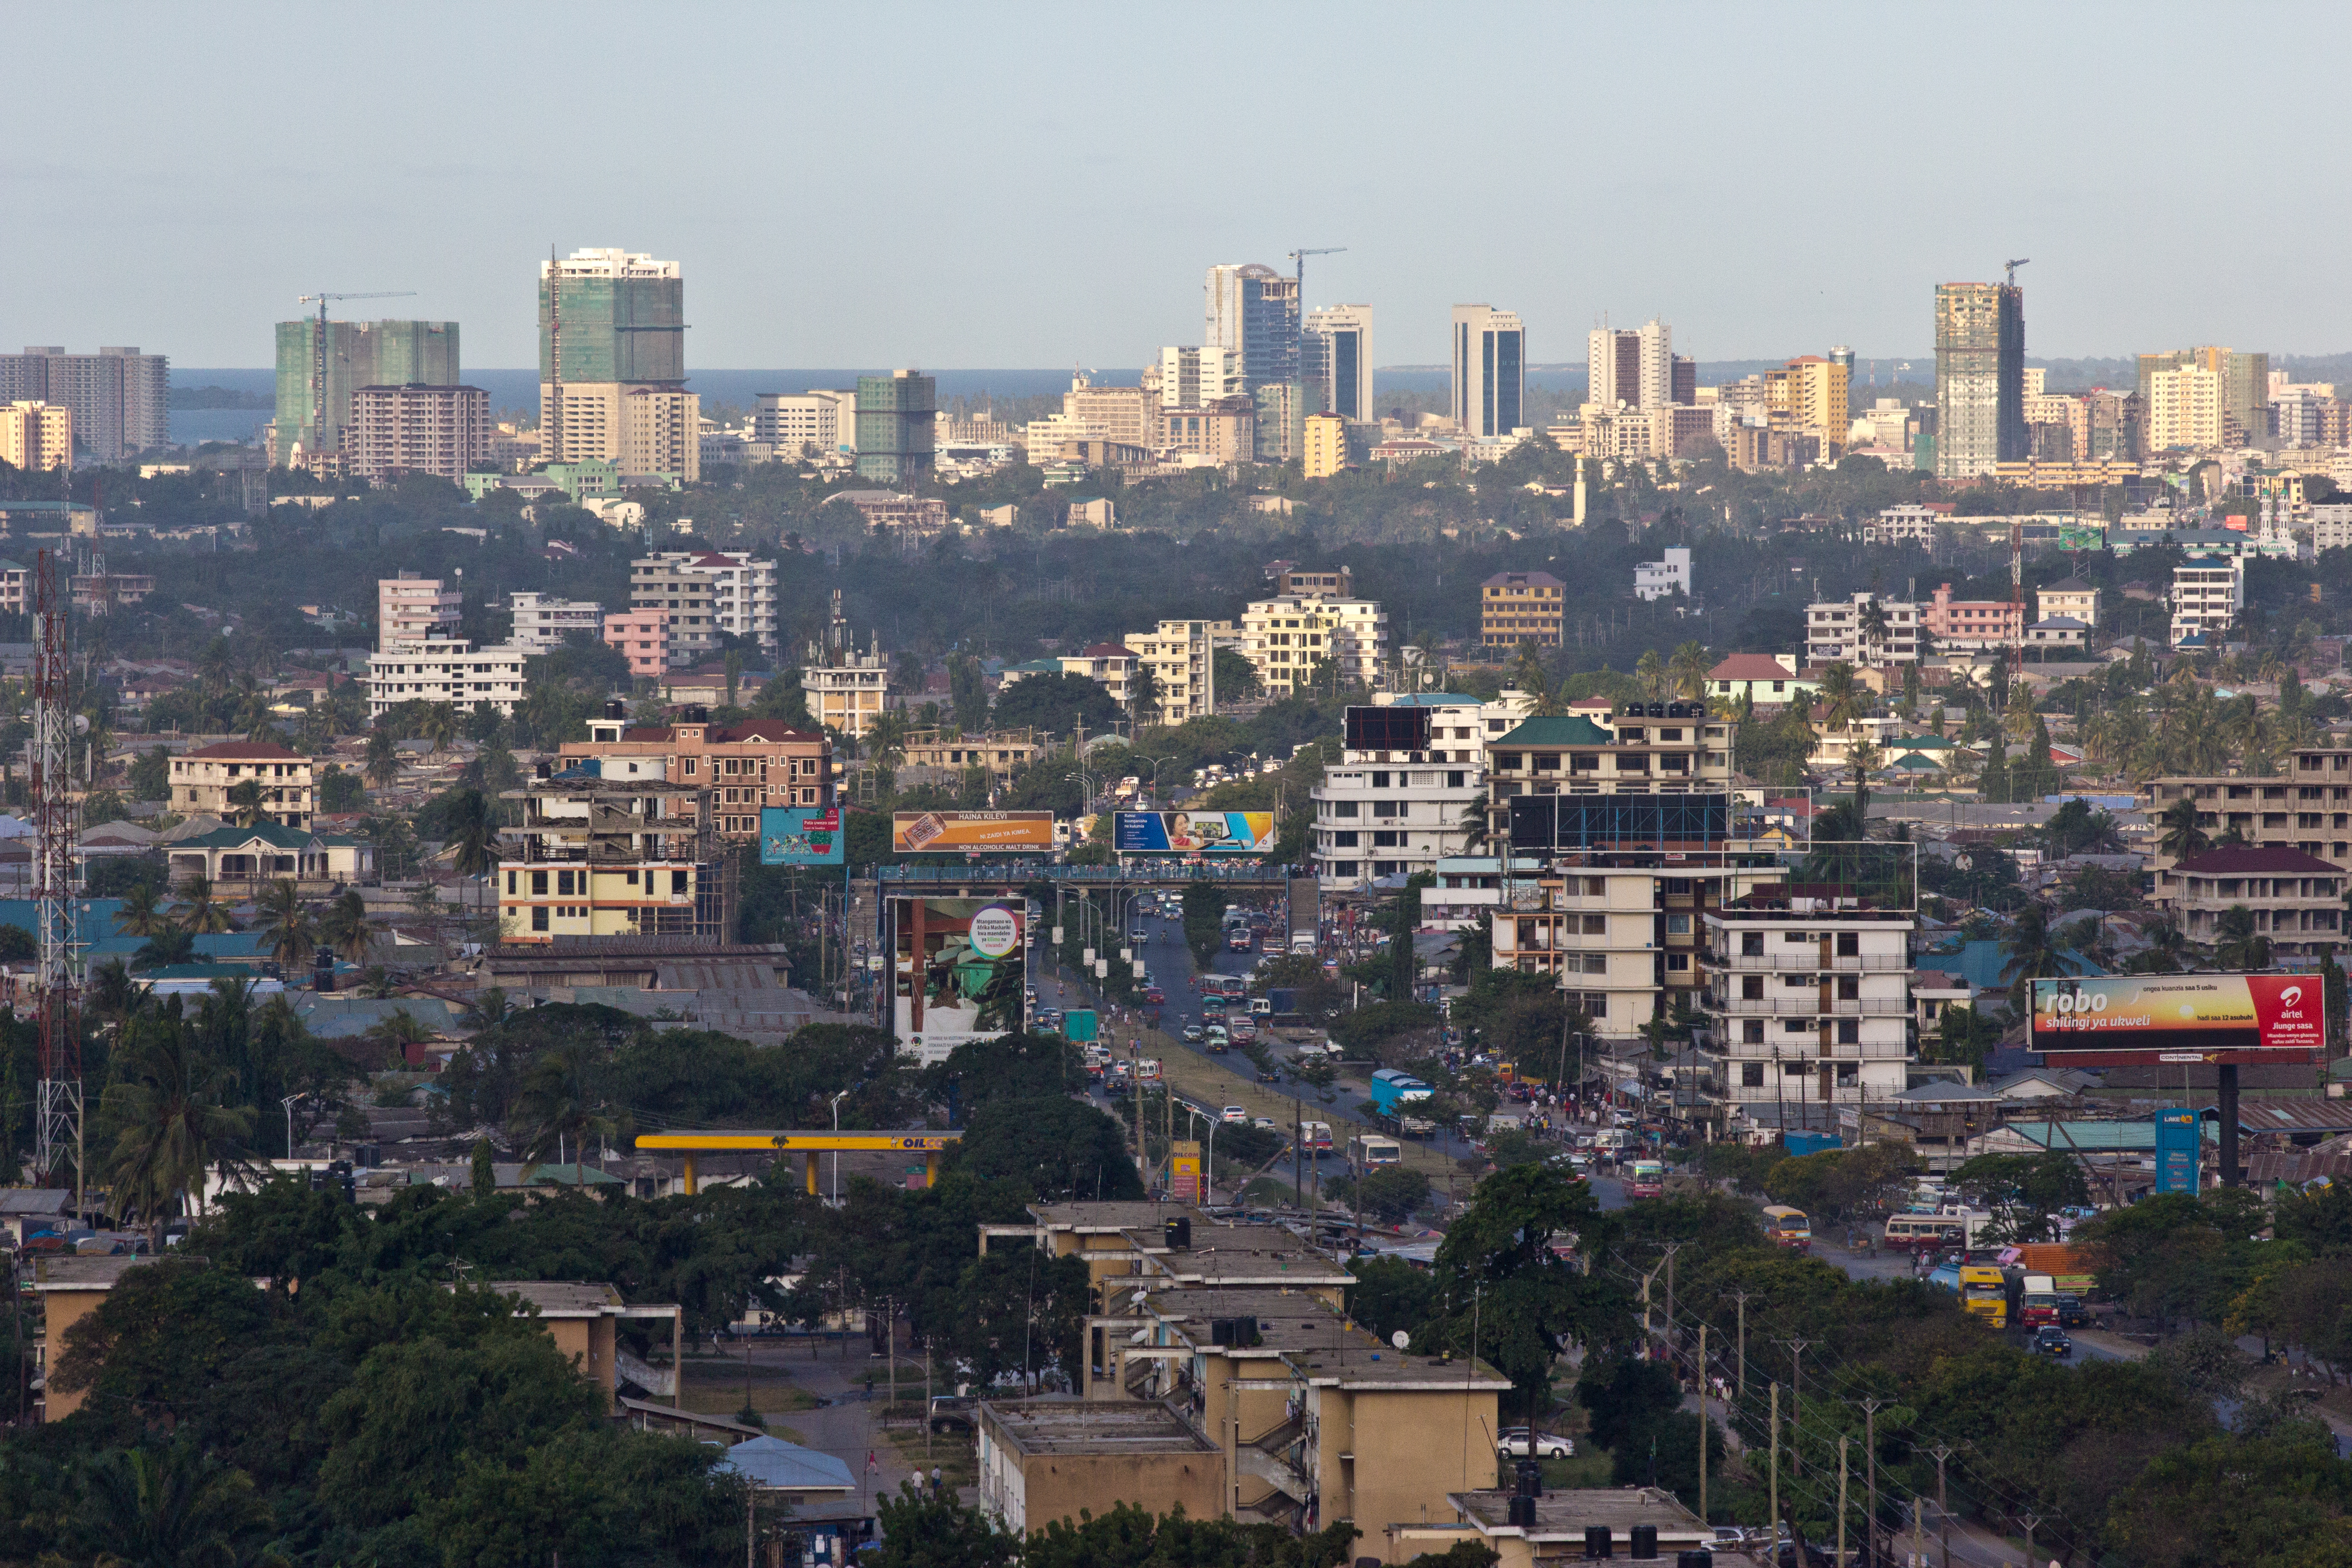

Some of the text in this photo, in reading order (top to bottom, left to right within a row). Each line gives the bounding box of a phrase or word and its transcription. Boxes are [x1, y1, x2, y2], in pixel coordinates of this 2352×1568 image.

[911, 824, 931, 842] Malt
[919, 817, 941, 838] Grand
[2046, 988, 2108, 1013] robo
[2046, 1014, 2151, 1030] shilingi ya ukweli
[2281, 1010, 2303, 1019] airtel
[2273, 1022, 2296, 1031] Jiunge
[902, 1138, 944, 1148] OILCO
